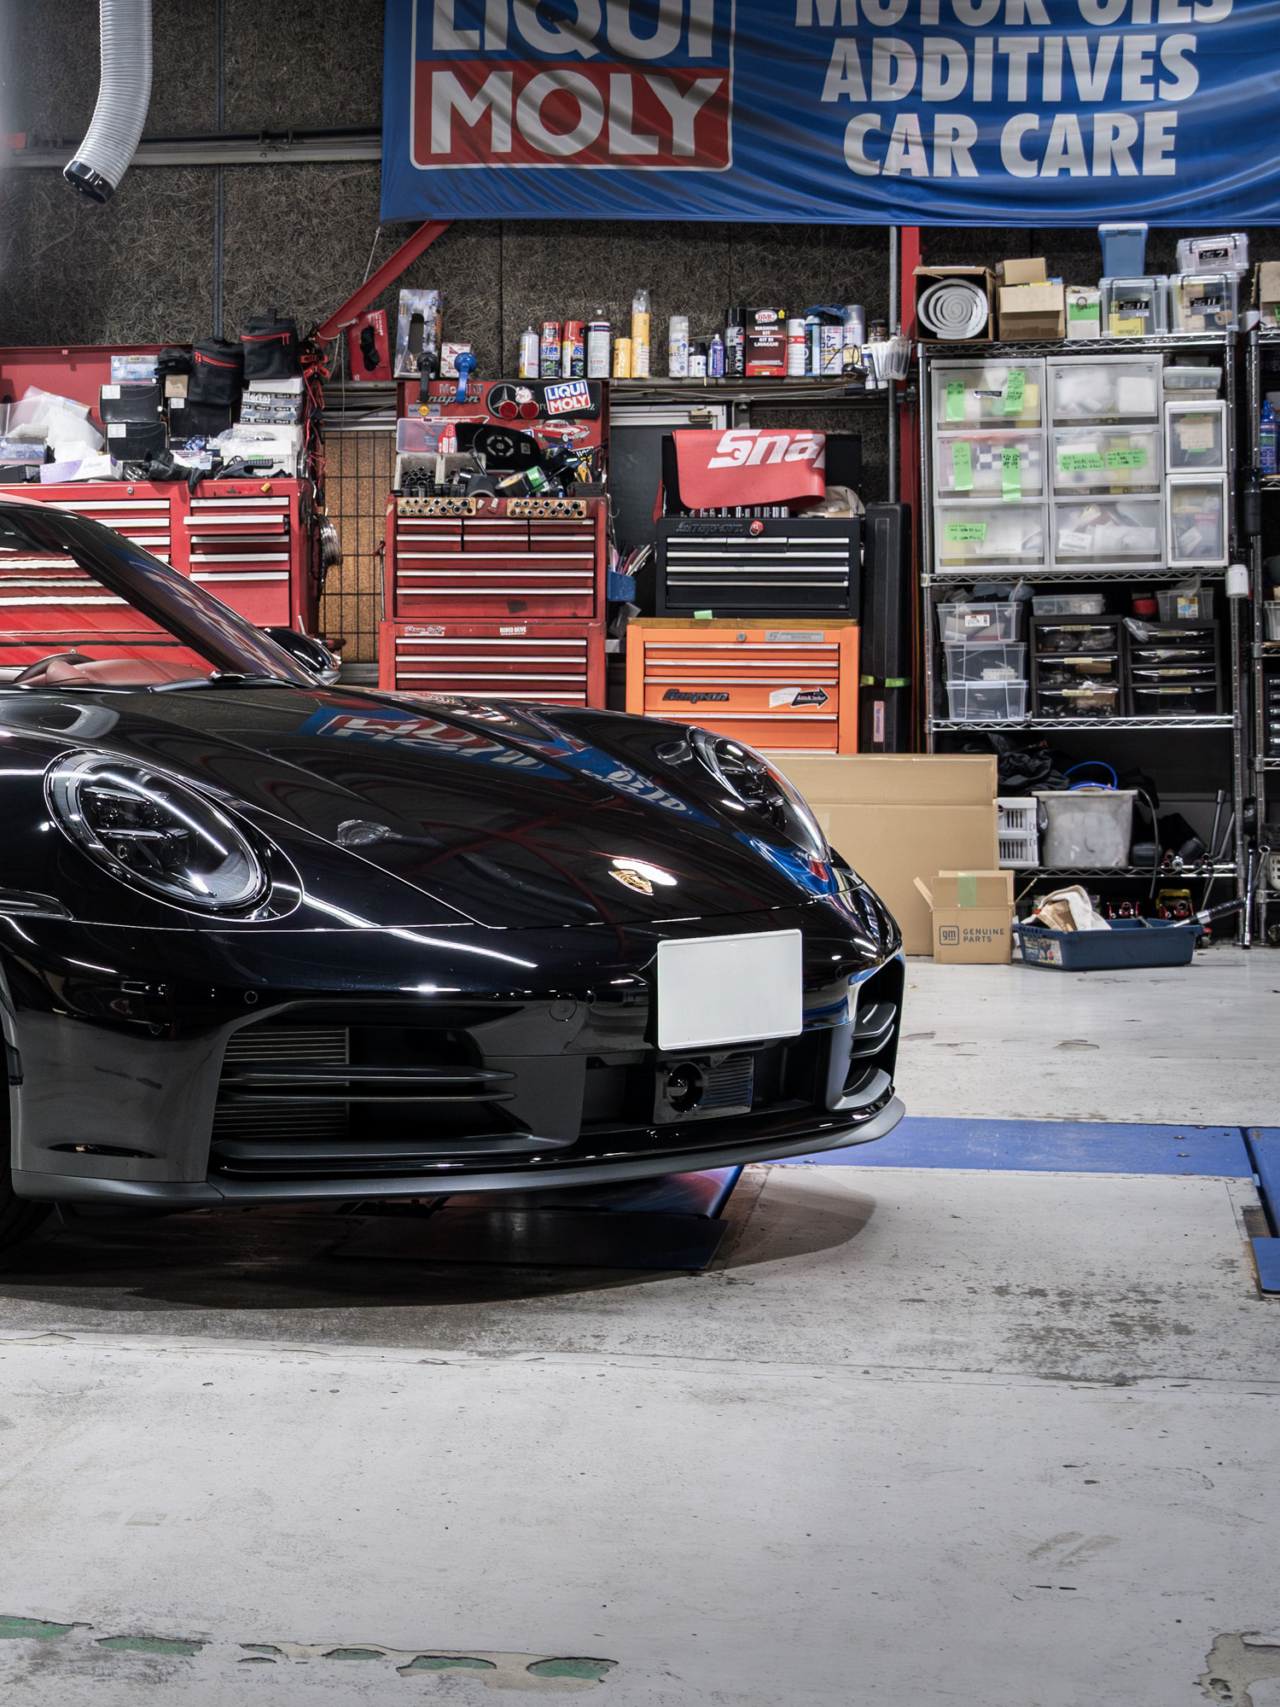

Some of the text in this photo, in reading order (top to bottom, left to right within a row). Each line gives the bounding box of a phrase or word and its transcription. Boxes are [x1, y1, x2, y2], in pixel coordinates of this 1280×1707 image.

[821, 34, 1200, 102] ADDITIVES
[430, 70, 724, 157] MOLY
[843, 111, 1178, 178] CAR CARE
[757, 312, 776, 321] BMC
[439, 383, 471, 395] Moil
[547, 381, 587, 401] LIQUI
[549, 394, 588, 413] MOLY
[942, 928, 1005, 941] gm GENUINE
[963, 935, 992, 943] PARTS
